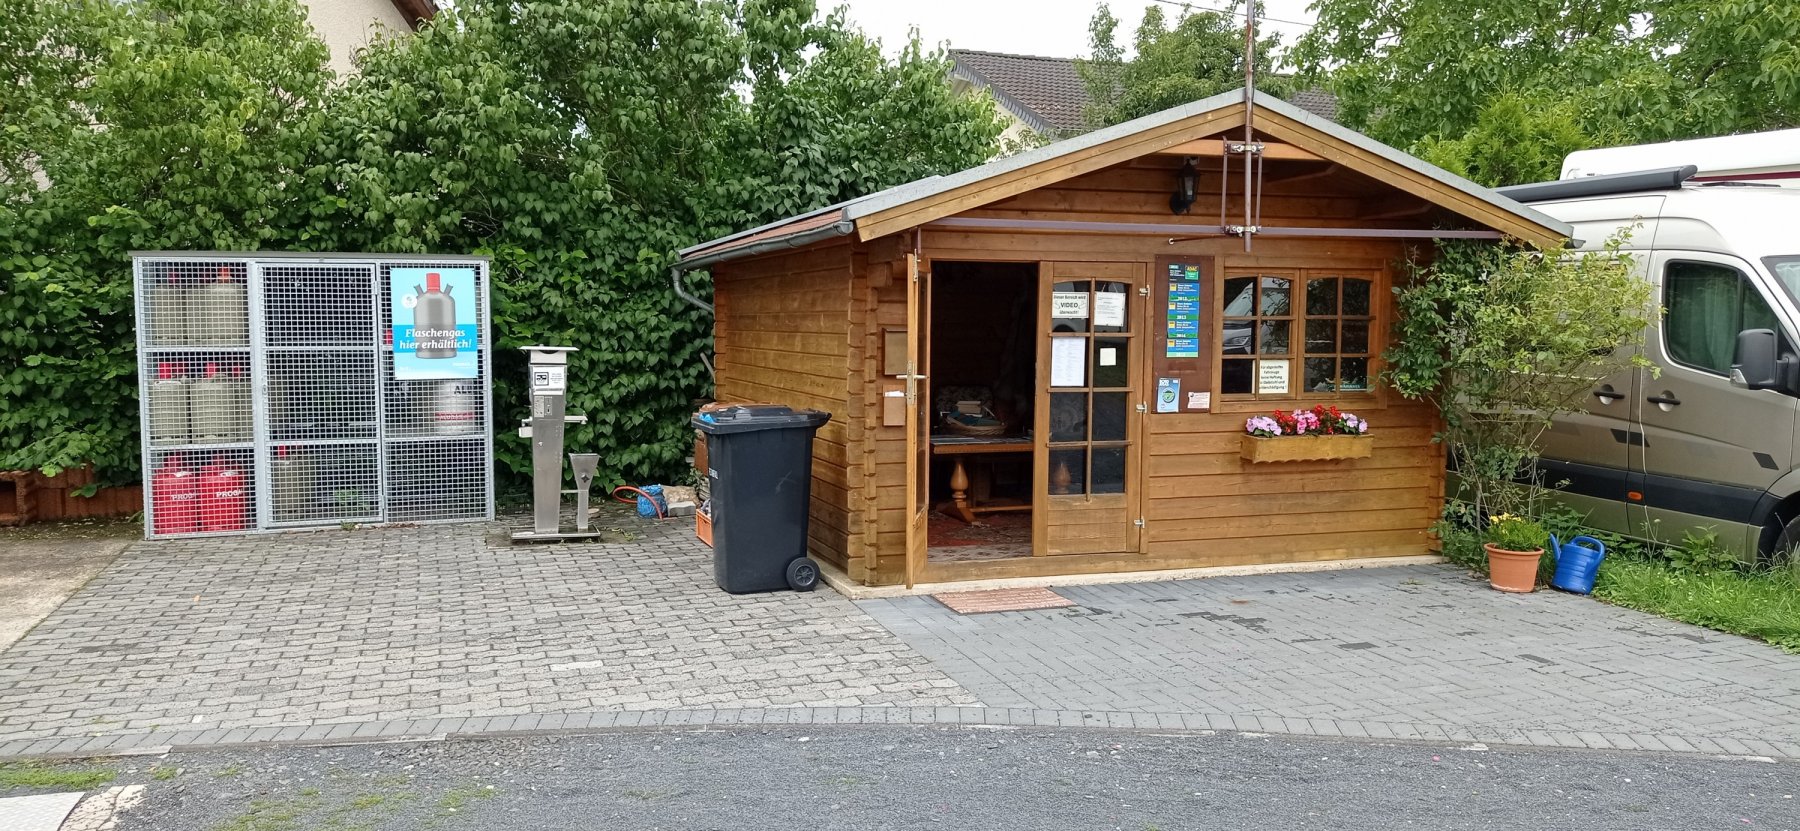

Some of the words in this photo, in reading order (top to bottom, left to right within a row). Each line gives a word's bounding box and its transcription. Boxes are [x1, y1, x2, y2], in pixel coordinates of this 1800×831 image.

[405, 328, 465, 339] Flaschengas
[399, 340, 420, 349] hier
[421, 339, 472, 349] erhältlich!
